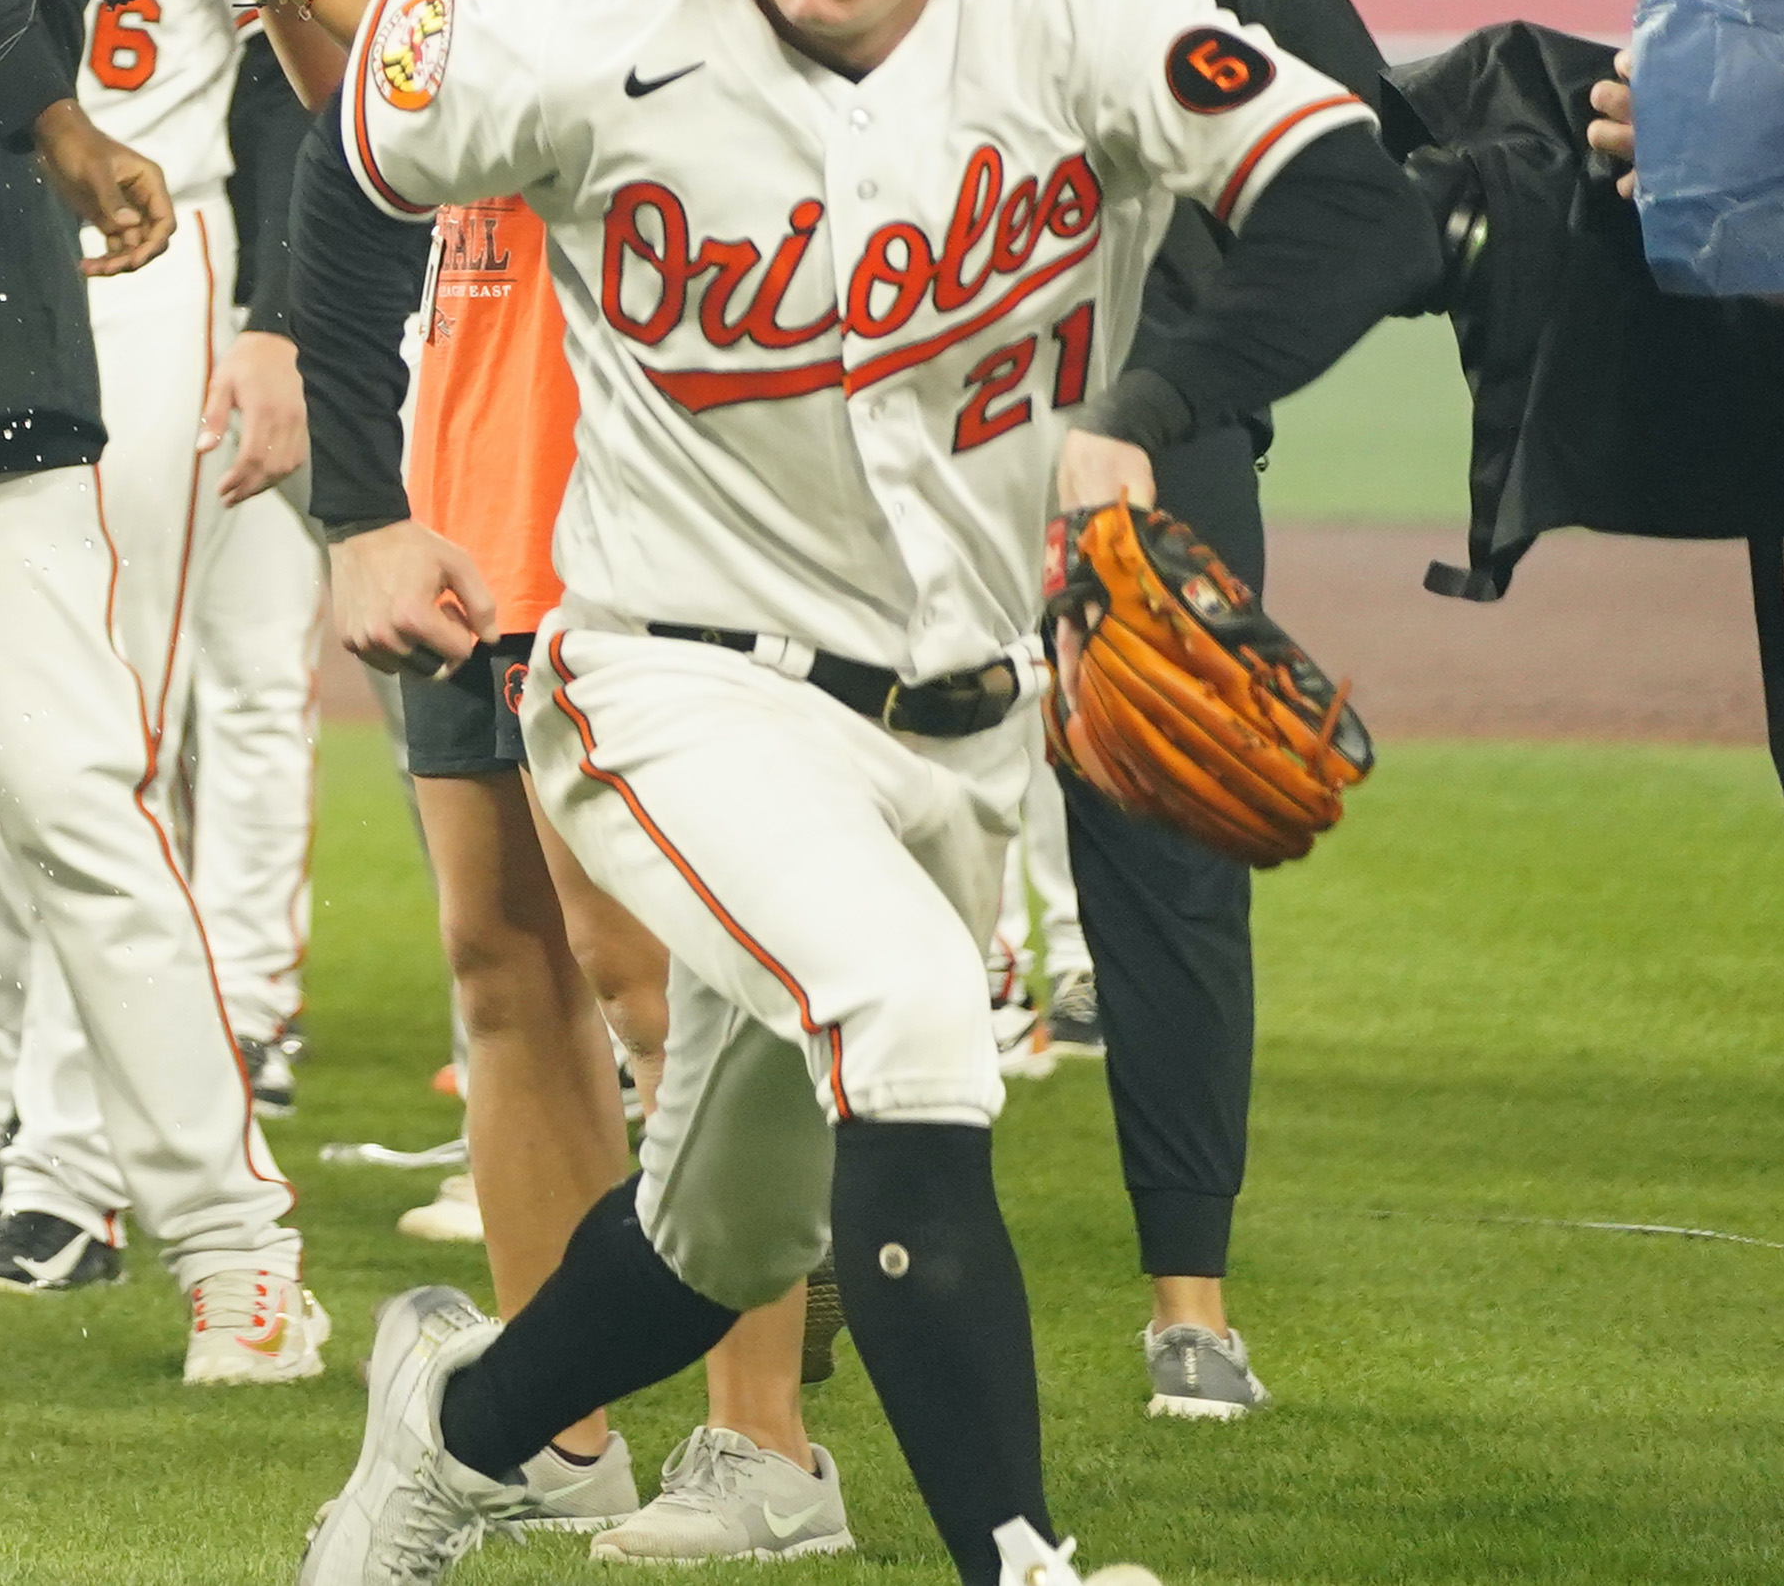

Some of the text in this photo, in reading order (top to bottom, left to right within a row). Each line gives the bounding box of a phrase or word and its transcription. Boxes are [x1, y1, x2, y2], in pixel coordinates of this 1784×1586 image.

[1186, 39, 1249, 93] 5
[469, 284, 512, 298] EAST
[602, 145, 1103, 350] Orioles
[952, 298, 1095, 455] 21
